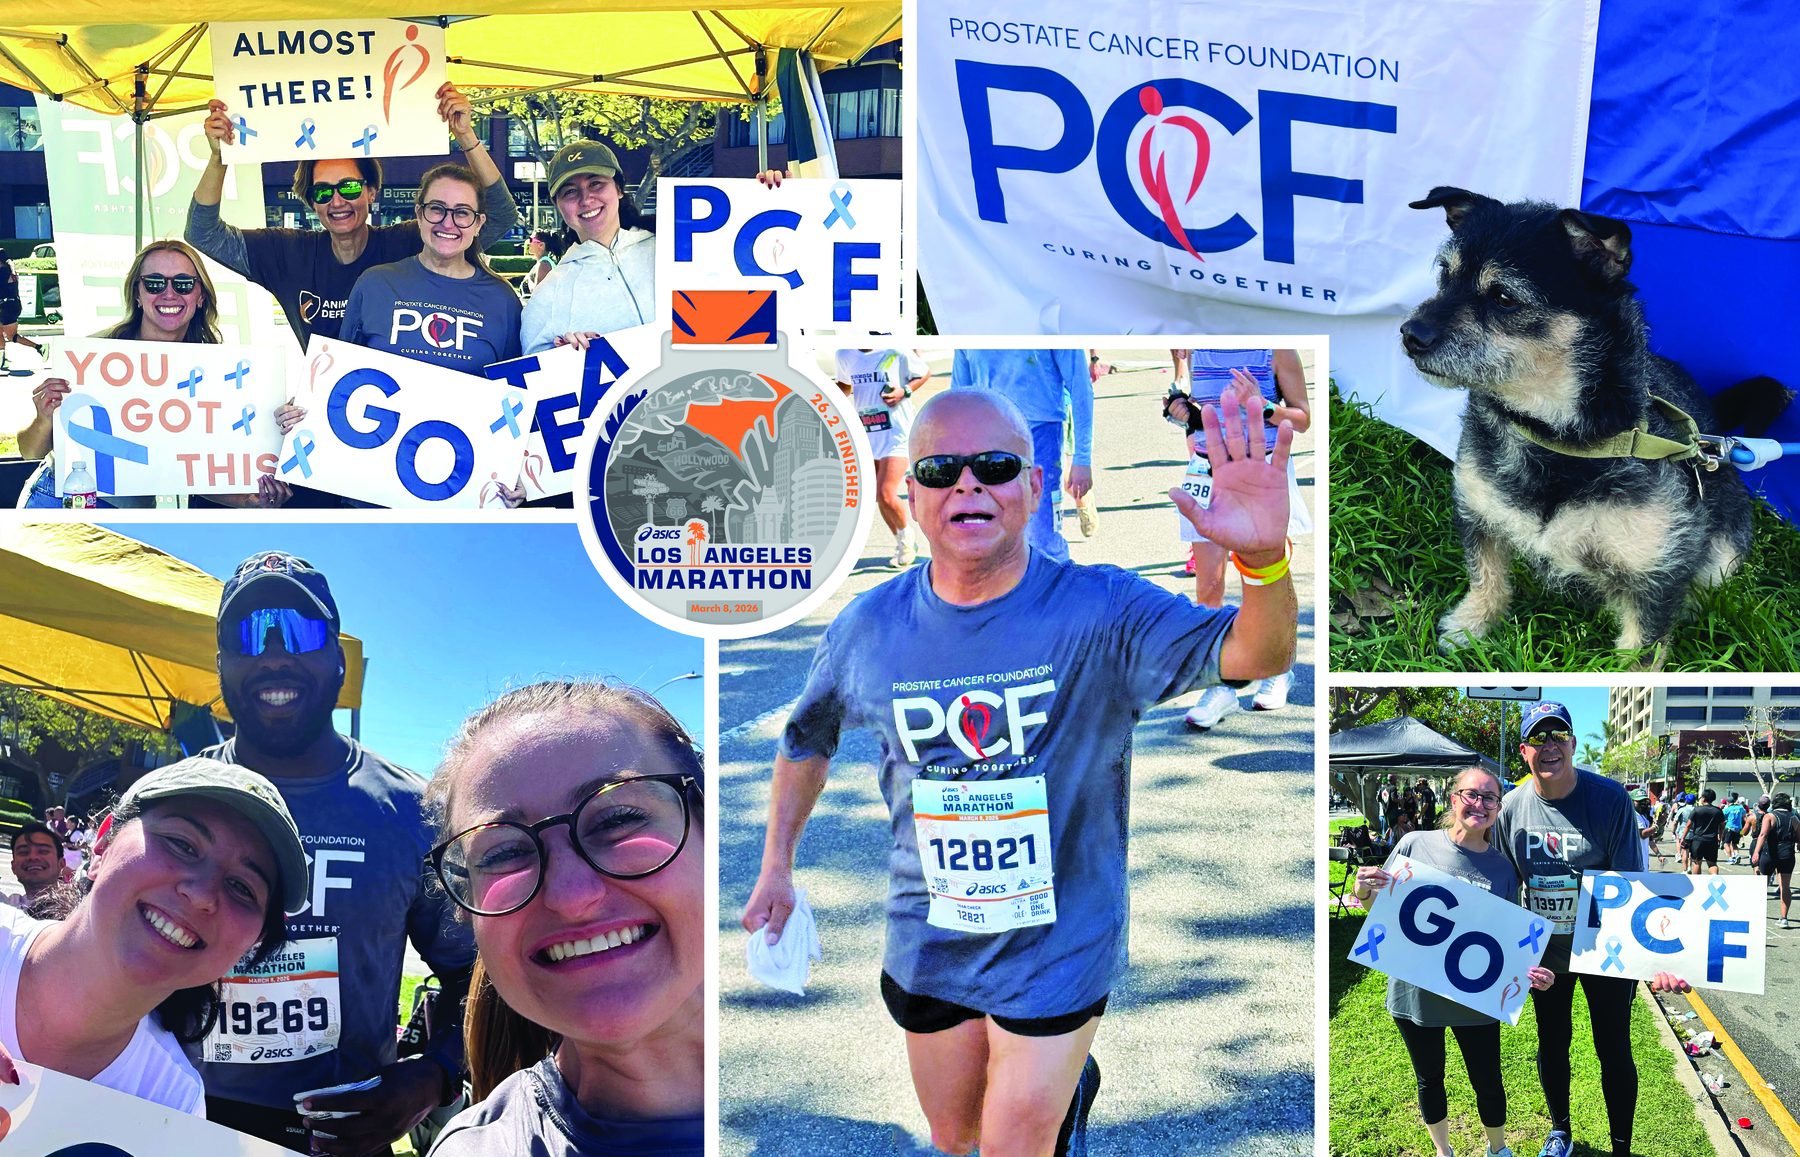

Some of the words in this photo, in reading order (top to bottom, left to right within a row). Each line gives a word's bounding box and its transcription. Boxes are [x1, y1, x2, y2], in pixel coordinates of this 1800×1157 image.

[233, 30, 376, 57] ALMOST
[949, 17, 1081, 50] PROSTATE
[1088, 30, 1199, 62] CANCER
[1208, 42, 1399, 83] FOUNDATION
[240, 76, 373, 108] THERE!
[955, 59, 1397, 265] PCF
[674, 185, 881, 322] PCF
[1043, 242, 1153, 272] CURING
[1170, 264, 1338, 303] TOGETHER
[424, 302, 447, 311] CANCER
[448, 306, 484, 318] FOUNDATION
[389, 308, 483, 350] PCF
[64, 351, 169, 387] YOU
[433, 351, 472, 360] TOGETHER
[121, 398, 221, 433] GOT
[327, 368, 475, 502] GO
[893, 680, 941, 692] PROSTATE
[943, 675, 985, 688] CANCER
[986, 664, 1054, 682] FOUNDATION
[892, 679, 1056, 762] PCF
[1530, 703, 1559, 719] PCF
[942, 794, 960, 802] LOS
[968, 792, 1013, 801] ANGELES
[943, 801, 1014, 812] MARATHON
[300, 835, 366, 846] FOUNDATION
[930, 833, 1037, 872] 12821
[1526, 831, 1583, 861] PCF
[1030, 892, 1048, 901] GOOD
[1031, 903, 1045, 911] ONE
[1533, 897, 1574, 911] 13977
[957, 910, 985, 923] 12821
[1031, 909, 1051, 917] DRINK
[1399, 884, 1505, 994] GO
[1588, 875, 1750, 984] PCF
[234, 961, 305, 974] MARATHON
[220, 997, 328, 1035] 19269
